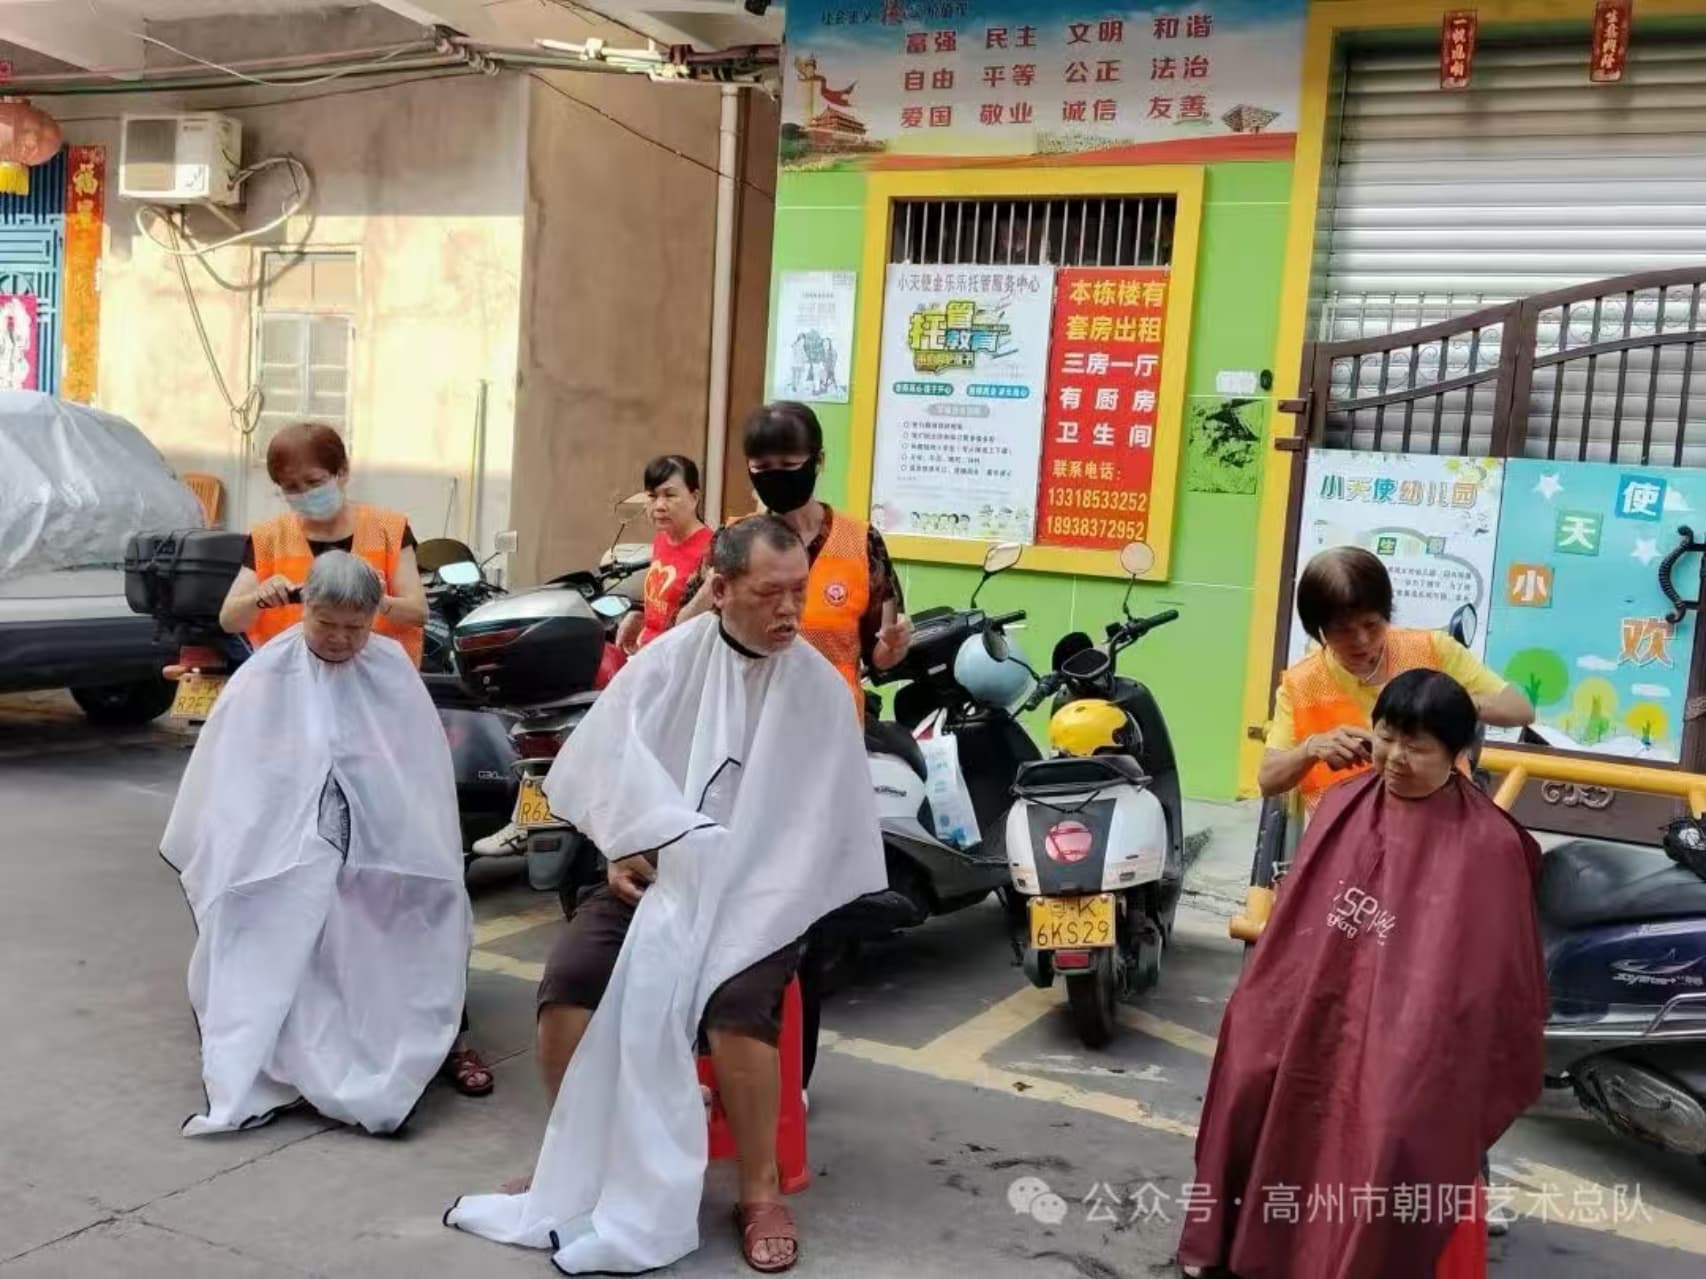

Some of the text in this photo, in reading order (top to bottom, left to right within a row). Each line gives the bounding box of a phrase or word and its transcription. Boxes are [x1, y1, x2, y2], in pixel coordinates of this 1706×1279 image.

[906, 15, 1213, 54] 富强 民主 文明 和谐
[904, 56, 1211, 91] 自由 平等 公正 法治
[901, 95, 1207, 129] 爱国 敬业 诚信 友善
[1069, 280, 1167, 307] 本栋楼有
[1065, 315, 1163, 343] 套房出租
[1061, 352, 1160, 378] 三房一厅
[1059, 387, 1157, 412] 有厨房
[1055, 421, 1153, 448] 卫生间
[1047, 487, 1148, 513] 13318533252
[1320, 474, 1478, 510] 小天使幼儿园
[1045, 515, 1146, 541] 18938372952
[1618, 616, 1679, 668] 欢
[1036, 919, 1110, 946] 6KS29
